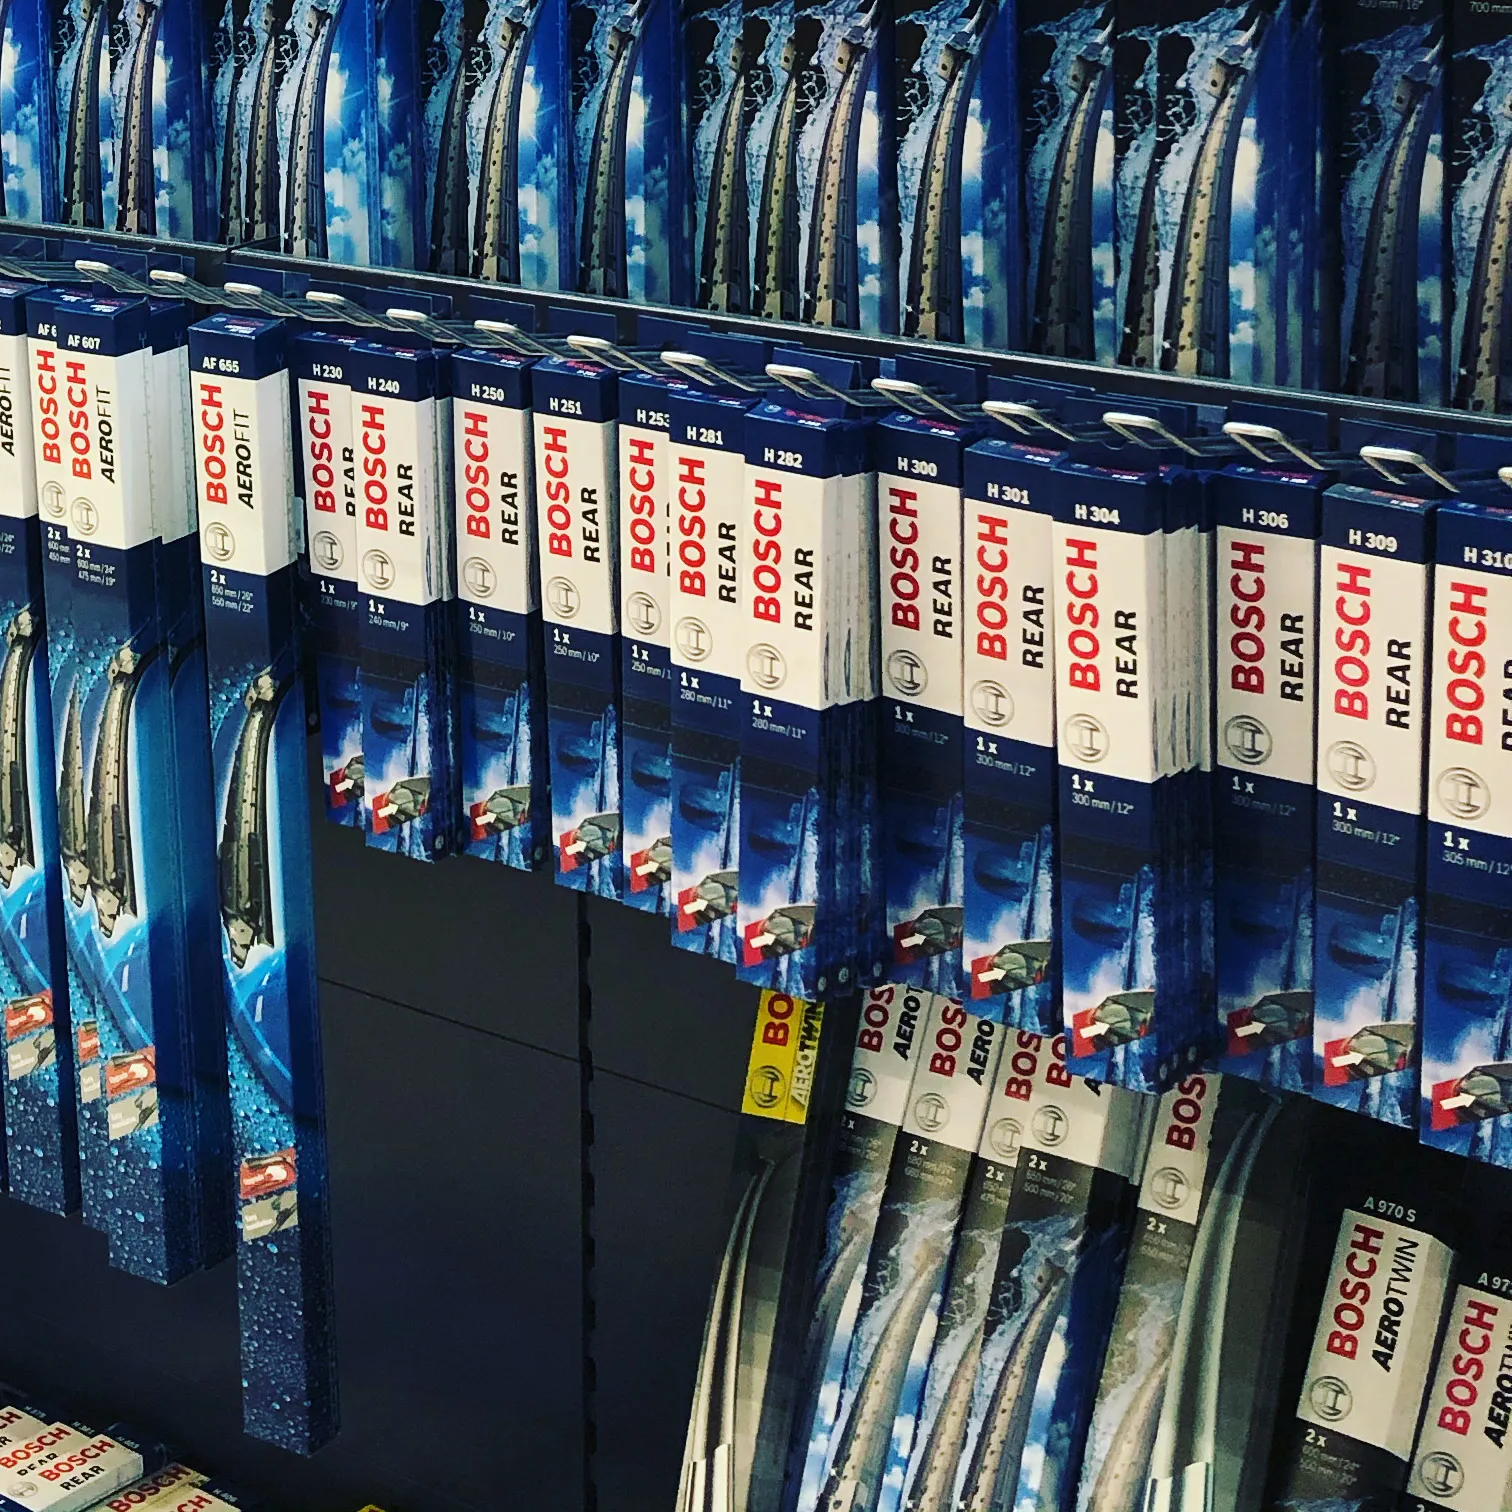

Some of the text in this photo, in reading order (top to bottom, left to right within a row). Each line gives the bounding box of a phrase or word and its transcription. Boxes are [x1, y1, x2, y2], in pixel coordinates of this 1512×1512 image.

[68, 335, 100, 349] AF 607
[203, 357, 239, 373] AF 655
[368, 377, 399, 393] H 240
[66, 361, 91, 479] BOSCH
[96, 386, 114, 483] AEROFIT
[201, 384, 227, 504] BOSCH
[234, 410, 253, 509] AEROFIT
[765, 448, 802, 468] H 282
[362, 405, 388, 530] BOSCH
[397, 464, 414, 536] REAR
[898, 457, 937, 476] H 300
[753, 480, 782, 623] BOSCH
[1075, 504, 1120, 524] H 304
[1243, 508, 1288, 528] H 306
[1349, 529, 1397, 552] H 309
[795, 548, 813, 630] REAR
[890, 488, 920, 630] BOSCH
[932, 556, 952, 638] REAR
[1066, 538, 1100, 691] BOSCH
[1115, 611, 1138, 698] REAR
[1230, 541, 1267, 694] BOSCH
[1281, 614, 1303, 701] REAR
[1335, 563, 1371, 719] BOSCH
[1386, 639, 1411, 729] REAR
[1364, 1197, 1416, 1222] A 970 S
[1328, 1228, 1383, 1360] BOSCH
[1372, 1237, 1419, 1373] AEROTWIN
[1437, 1300, 1498, 1435] BOSCH
[38, 1439, 115, 1482] BOSCH
[60, 1464, 105, 1490] REAR
